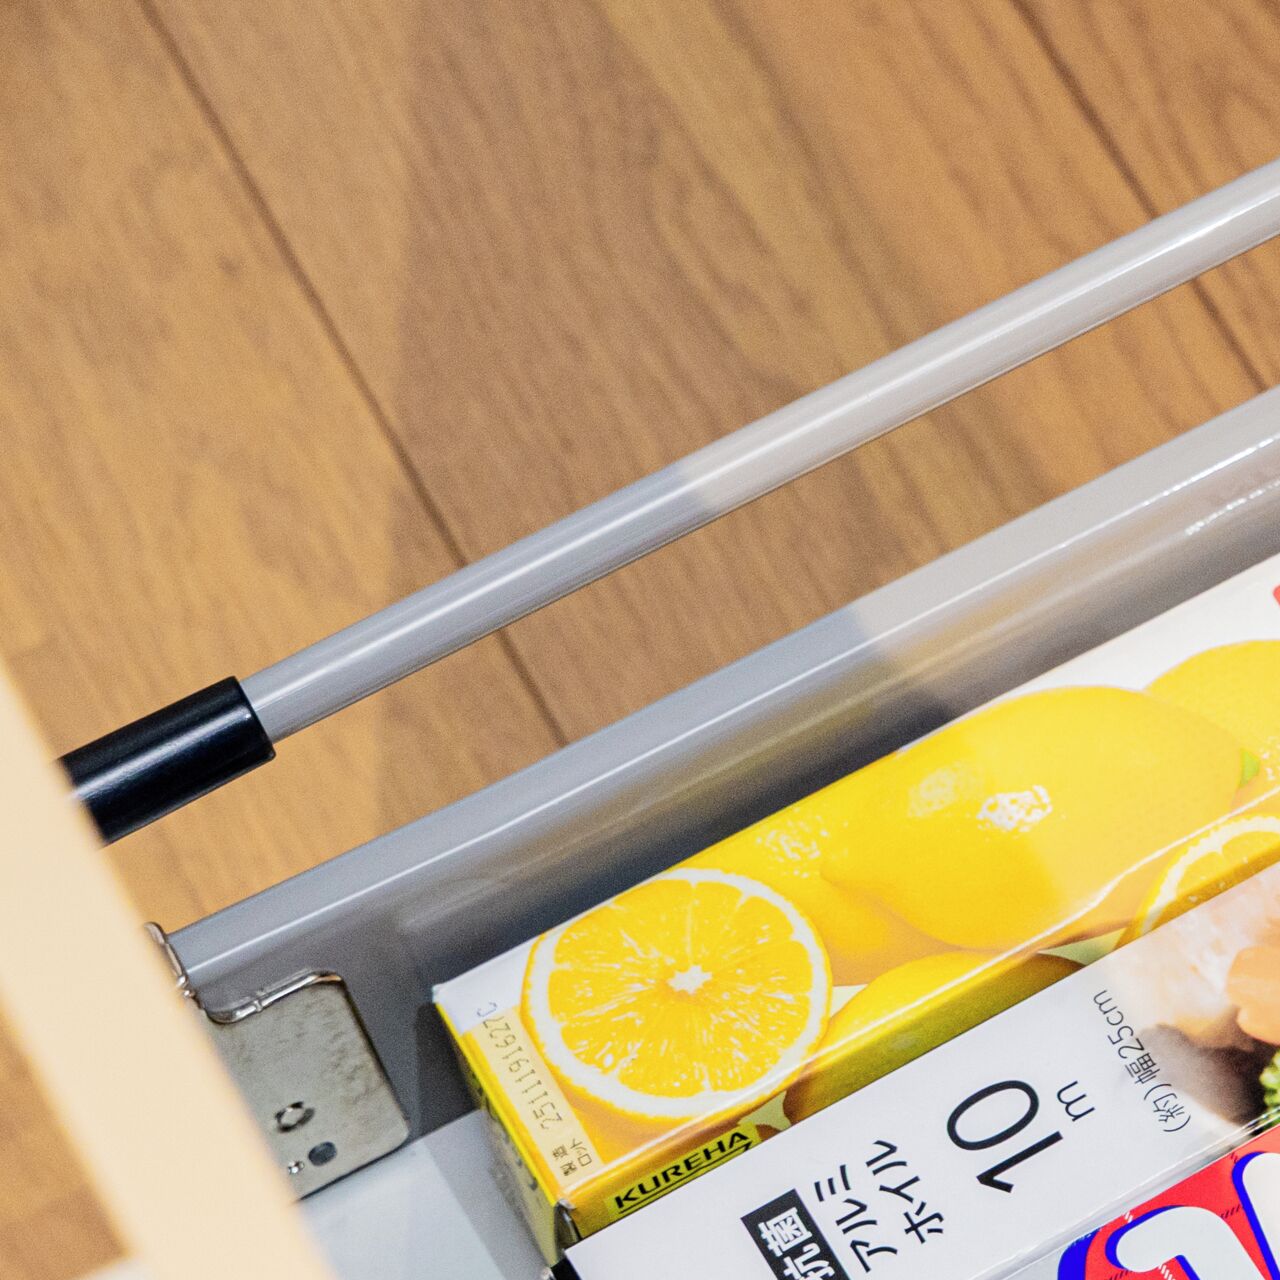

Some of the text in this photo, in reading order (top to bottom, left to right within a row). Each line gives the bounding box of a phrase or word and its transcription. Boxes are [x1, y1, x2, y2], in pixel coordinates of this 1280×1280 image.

[614, 1130, 752, 1209] KUREHA
[946, 1079, 1064, 1194] 10
[815, 1163, 898, 1274] アルミ
[864, 1138, 945, 1246] ホイル
